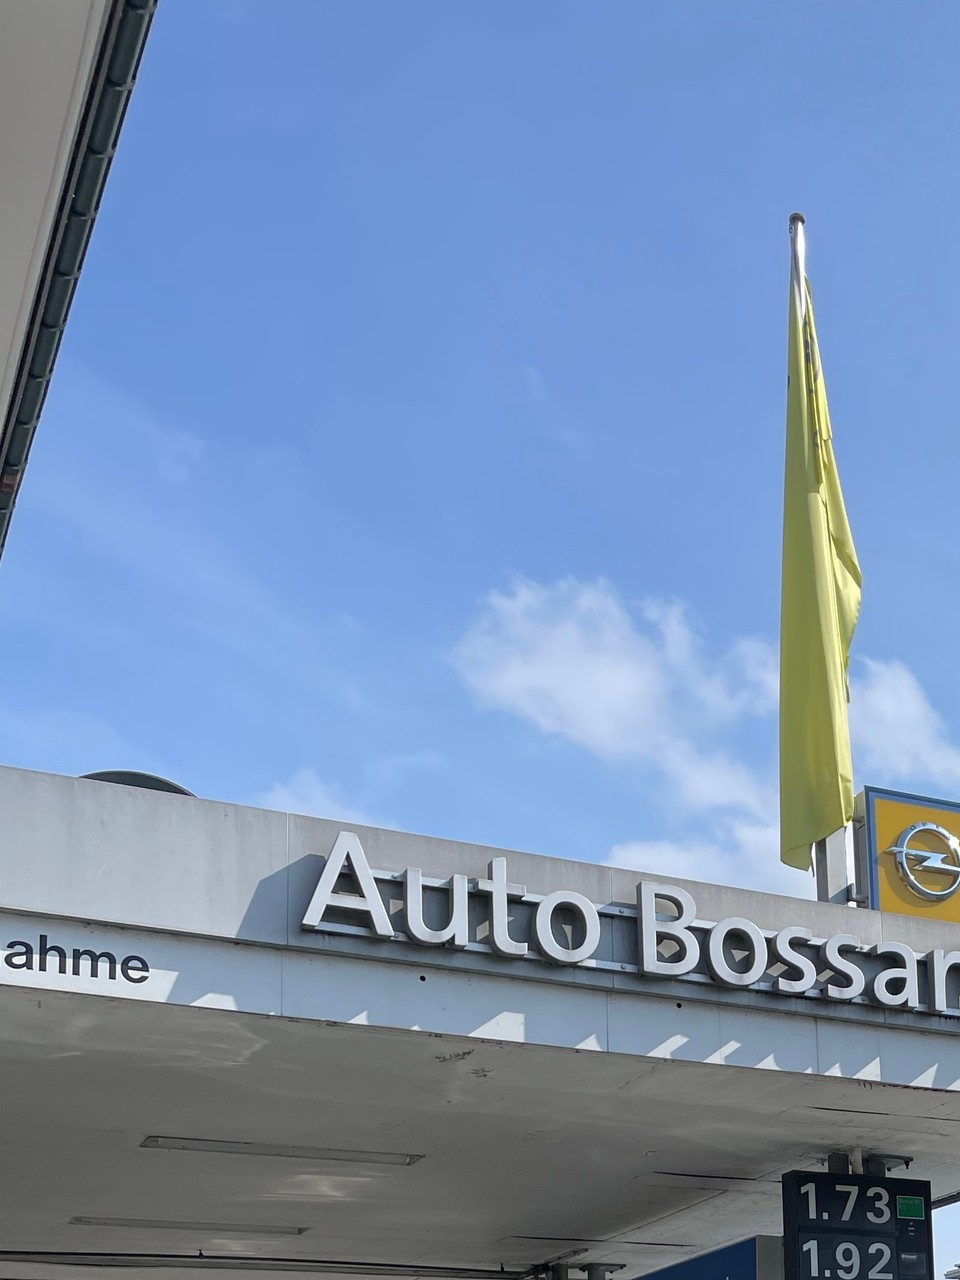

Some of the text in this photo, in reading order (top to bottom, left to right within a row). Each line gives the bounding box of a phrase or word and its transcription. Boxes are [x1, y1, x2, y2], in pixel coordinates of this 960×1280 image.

[302, 831, 600, 964] Auto
[4, 934, 150, 984] ahme
[800, 1182, 891, 1224] 1.73
[802, 1239, 894, 1280] 1.92
